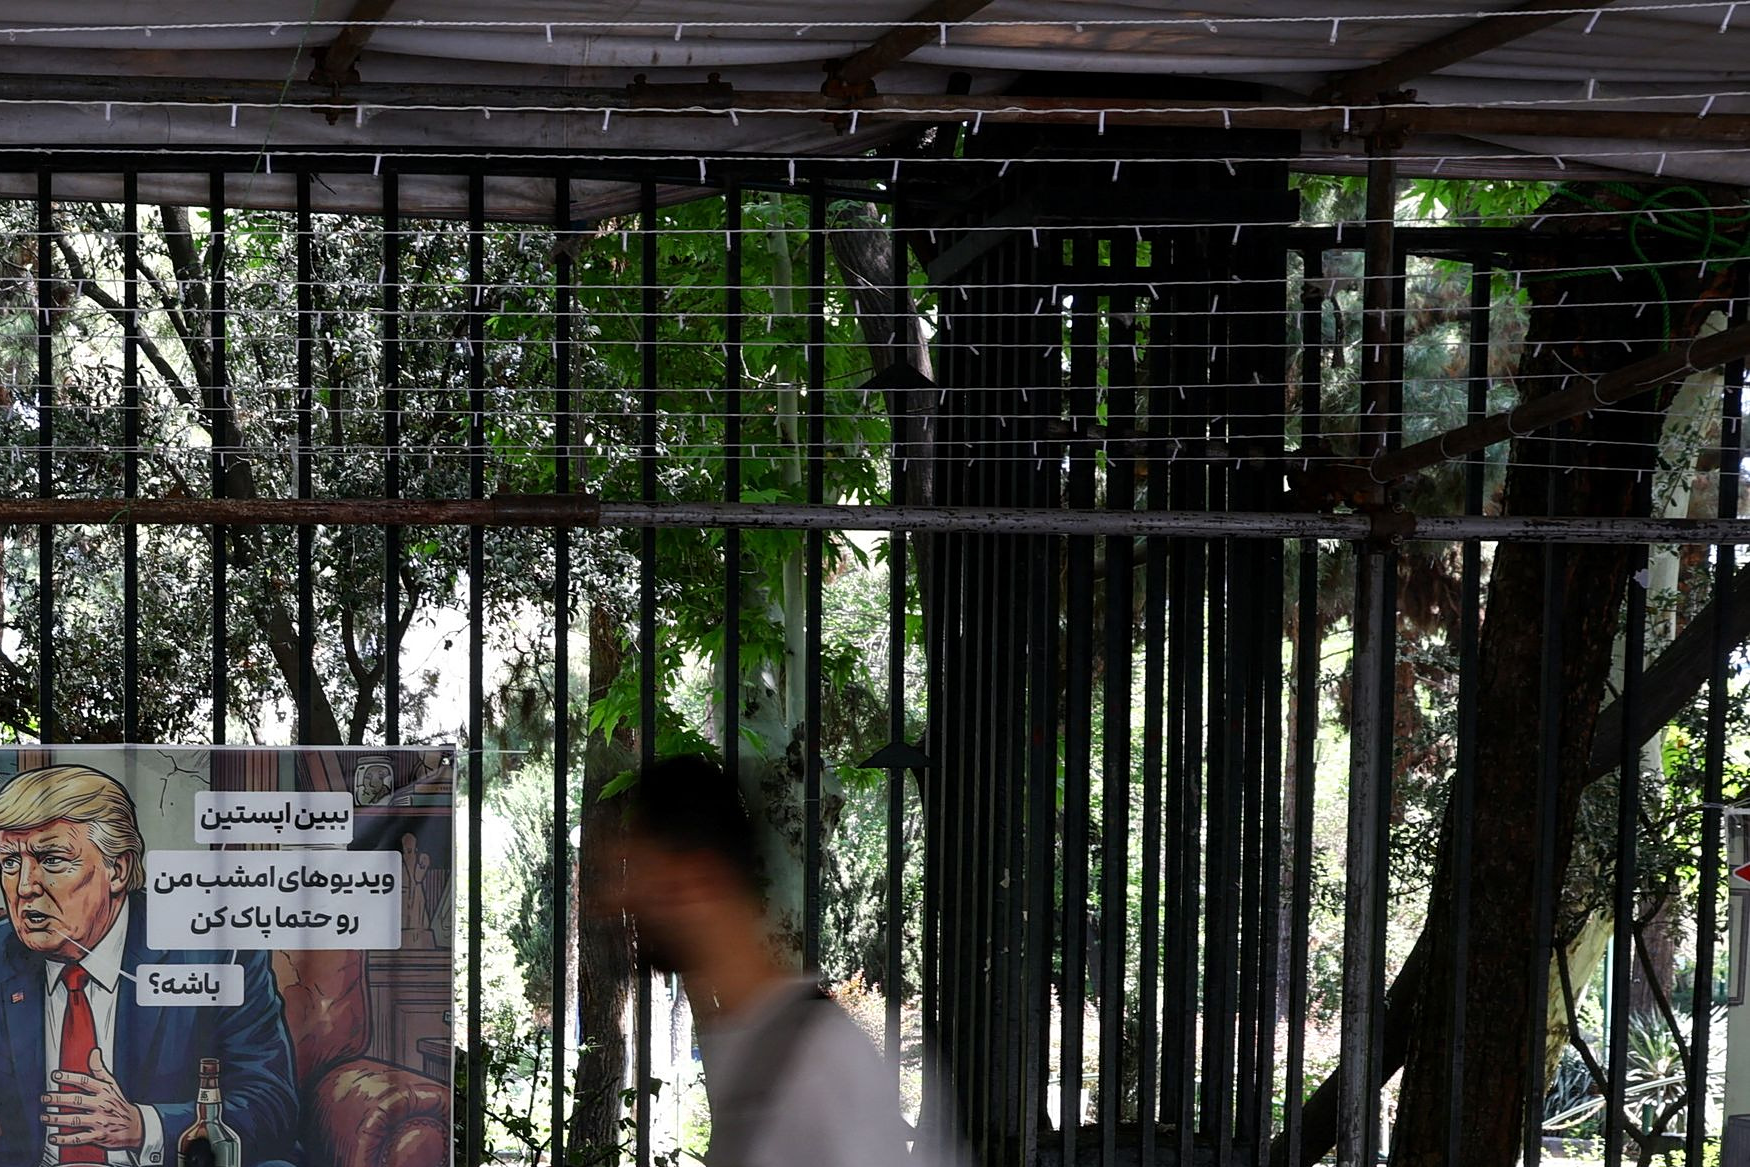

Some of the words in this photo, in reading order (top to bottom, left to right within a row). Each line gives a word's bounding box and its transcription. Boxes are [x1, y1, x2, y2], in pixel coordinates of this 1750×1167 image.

[201, 801, 291, 834] اپستین
[295, 809, 349, 831] ببین
[154, 872, 193, 895] من
[197, 865, 275, 894] امشب
[278, 865, 395, 895] ویدیوهای
[191, 906, 229, 935] کن
[230, 906, 272, 938] پاک
[276, 905, 333, 929] حتما
[337, 914, 359, 936] رو
[148, 972, 220, 1002] باشه؟
